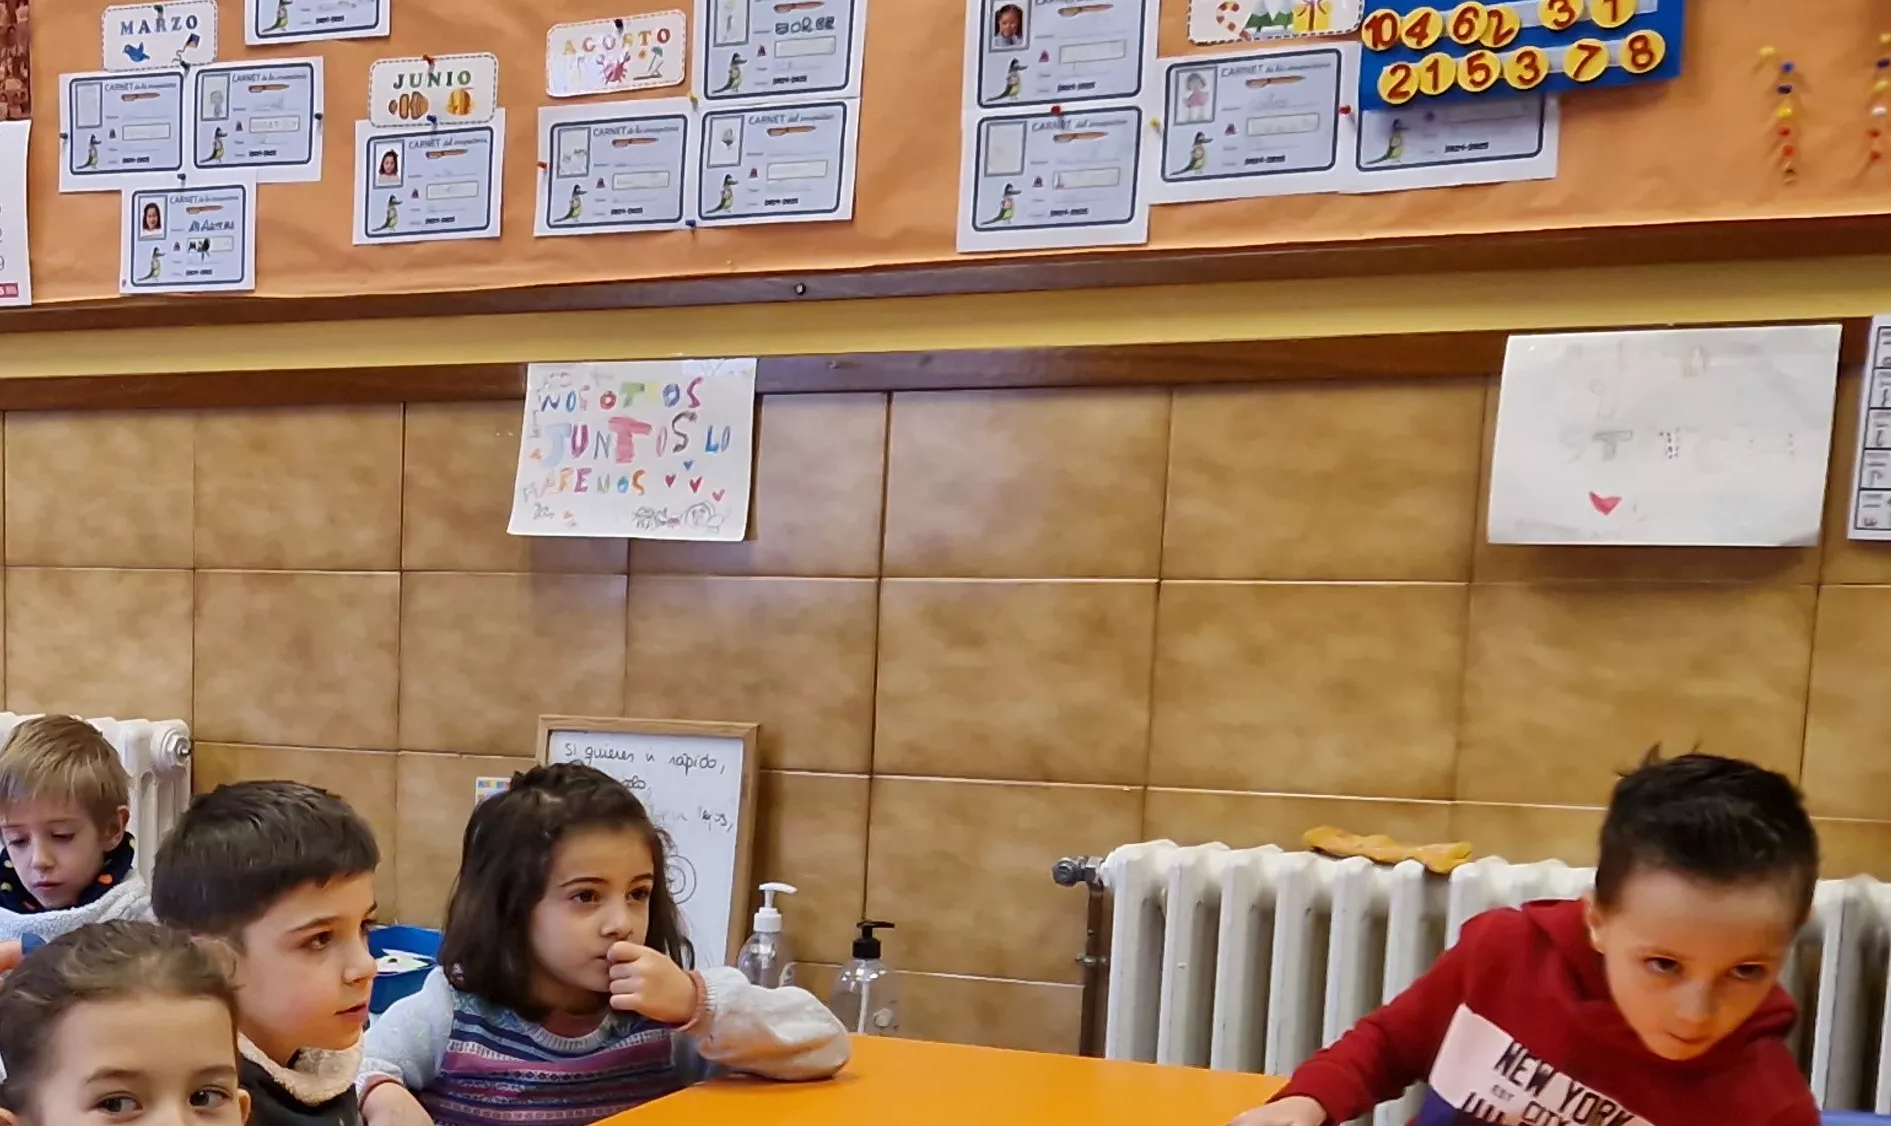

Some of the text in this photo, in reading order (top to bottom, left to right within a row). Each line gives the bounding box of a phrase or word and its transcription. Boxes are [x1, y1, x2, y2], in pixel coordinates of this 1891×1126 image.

[119, 14, 198, 36] MARZO
[562, 27, 671, 56] AGOSTO
[1365, 14, 1398, 48] 10
[1405, 12, 1431, 45] 4
[1453, 6, 1479, 40] 6
[1488, 11, 1514, 46] 2
[1551, 0, 1576, 28] 3
[392, 70, 472, 89] JUNIO
[1387, 34, 1655, 99] 2 1 5 3 7 8
[539, 411, 731, 468] JUNTOS LO
[1493, 1040, 1557, 1097] NEW
